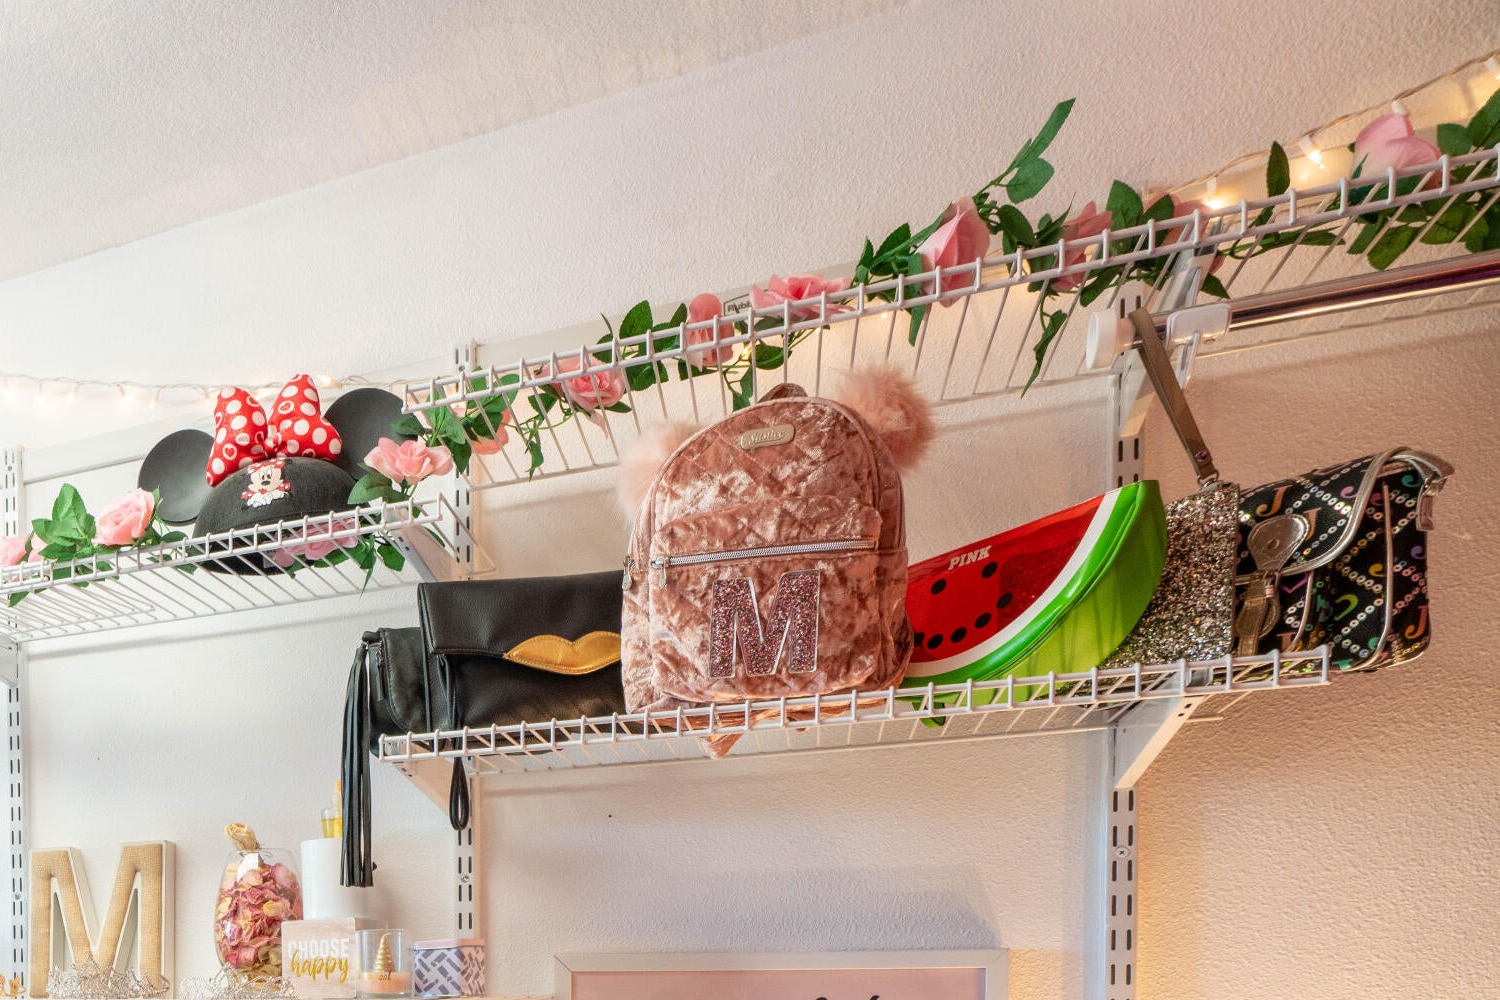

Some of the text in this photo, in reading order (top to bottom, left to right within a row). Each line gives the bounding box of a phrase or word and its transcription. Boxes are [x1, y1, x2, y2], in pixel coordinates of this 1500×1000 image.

[947, 544, 993, 571] PINK
[708, 569, 821, 679] M
[29, 839, 177, 999] M
[287, 937, 350, 960] CHOOSE
[290, 949, 349, 984] happy
